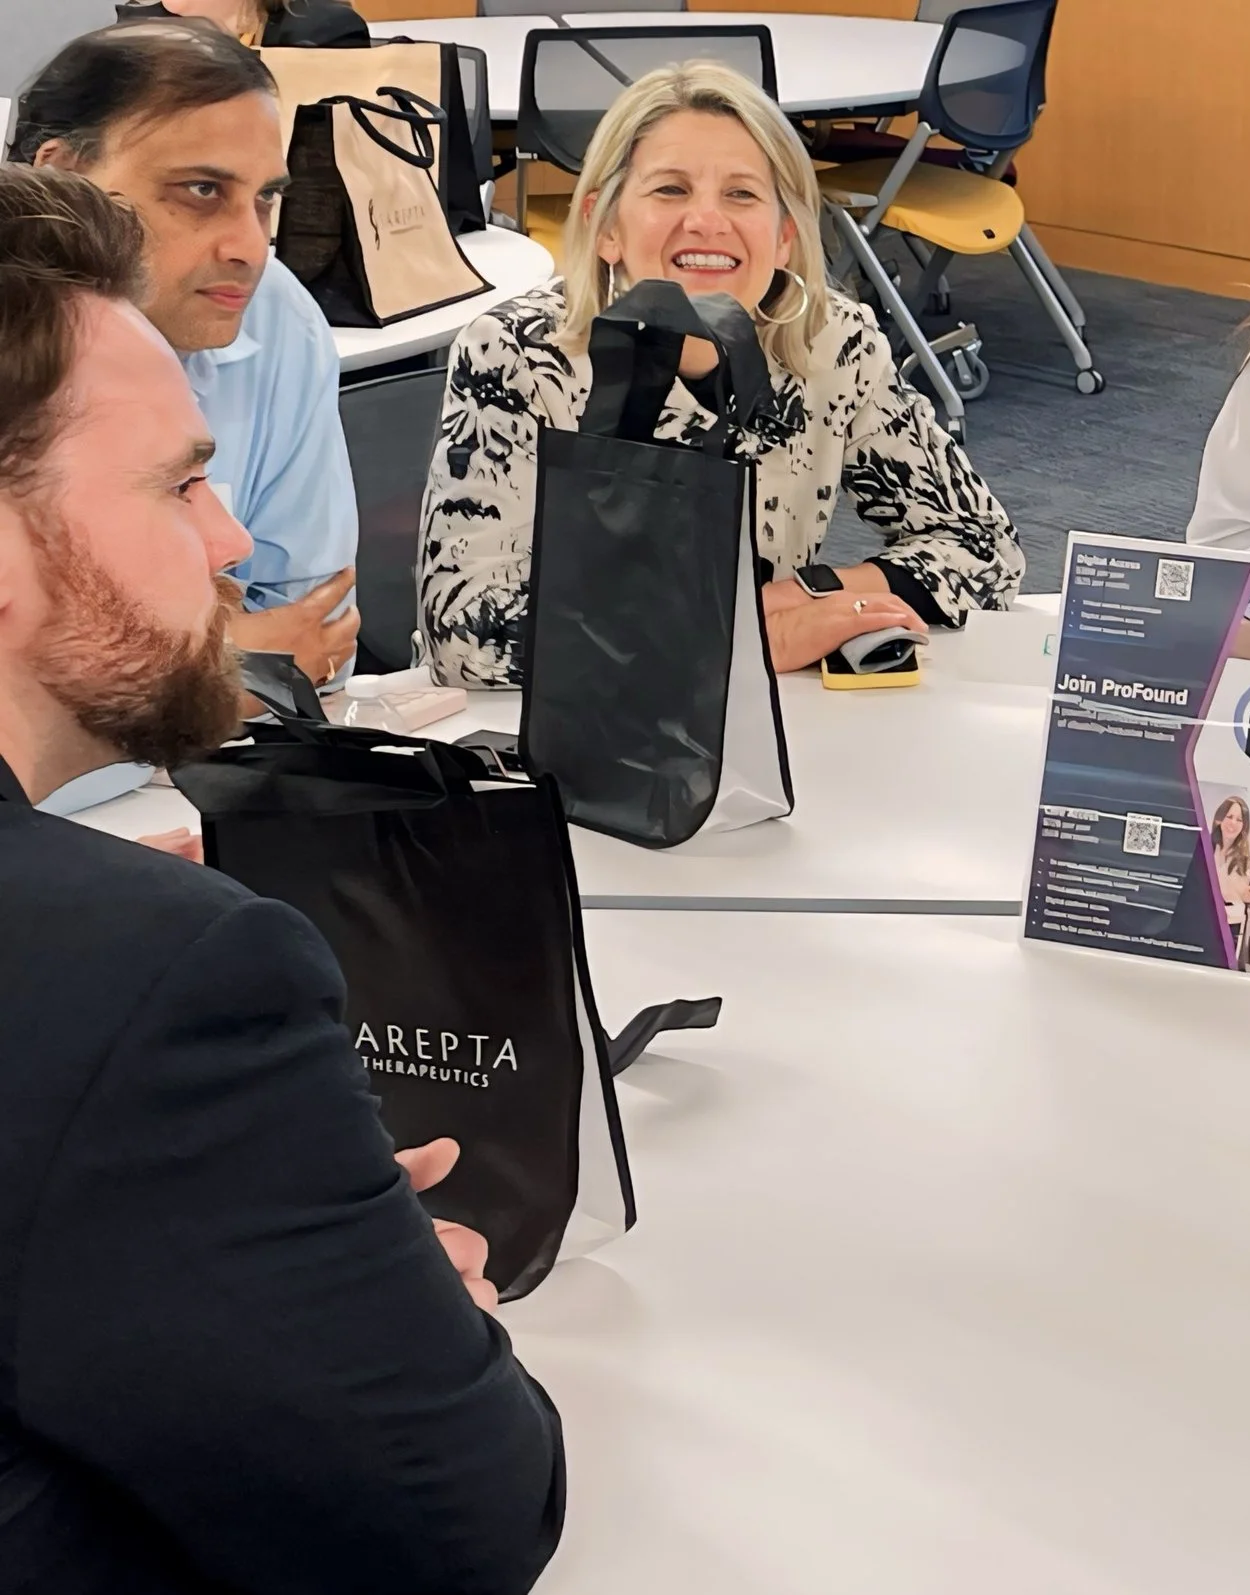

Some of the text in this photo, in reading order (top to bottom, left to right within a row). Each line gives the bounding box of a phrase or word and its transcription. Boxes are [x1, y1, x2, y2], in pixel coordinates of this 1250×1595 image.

[1058, 674, 1189, 706] Join ProFound
[354, 1021, 518, 1071] AREPTA
[361, 1056, 489, 1088] THERAPEUTICS
